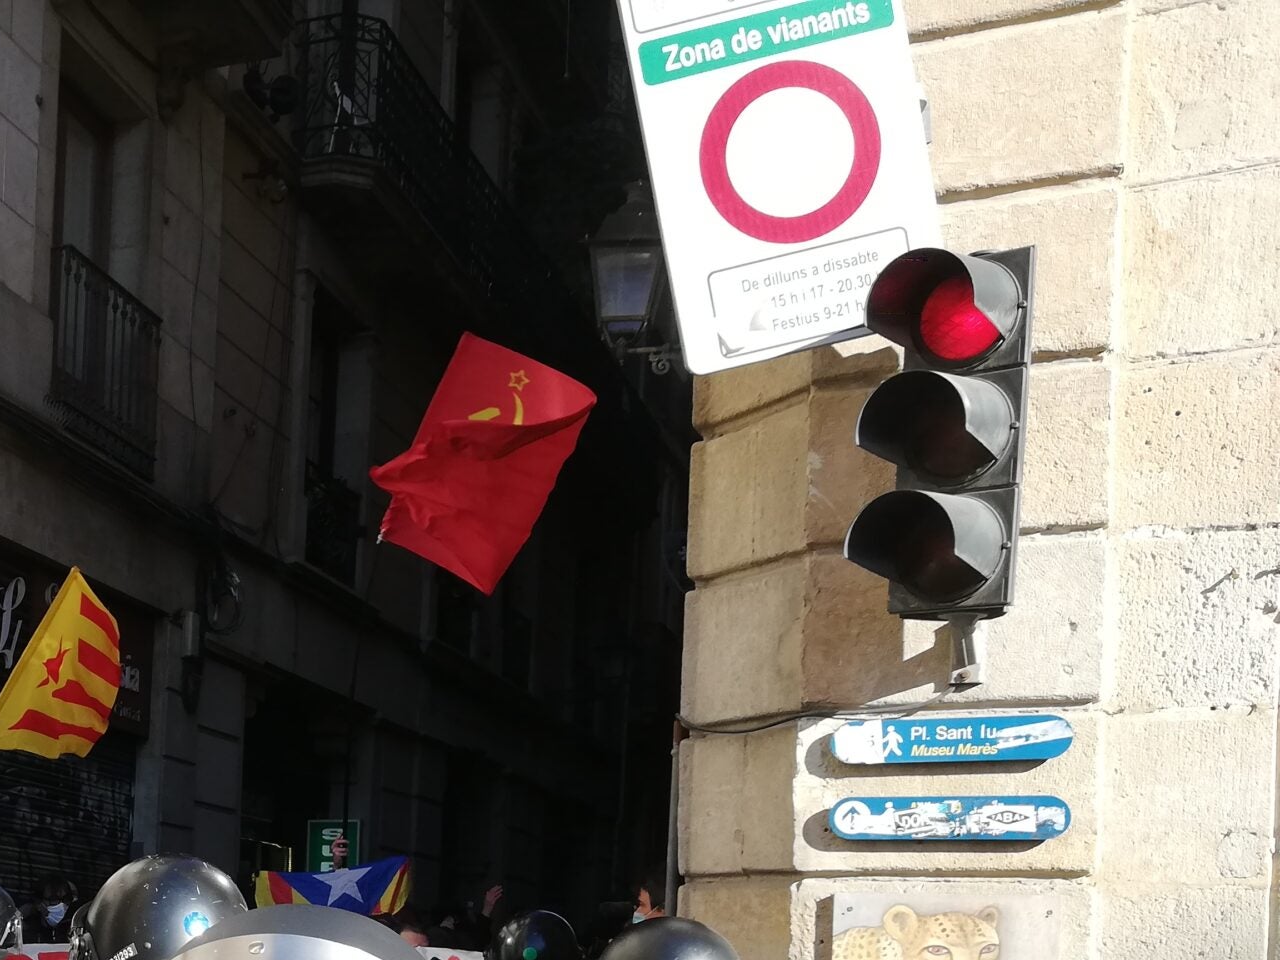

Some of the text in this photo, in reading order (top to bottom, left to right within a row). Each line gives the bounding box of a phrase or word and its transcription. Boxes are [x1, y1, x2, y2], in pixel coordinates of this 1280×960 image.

[661, 1, 871, 72] Zona de vianants
[741, 249, 879, 293] De dilluns a dissabte
[771, 294, 786, 308] 15
[790, 291, 799, 305] h
[802, 290, 806, 302] i
[810, 284, 824, 299] 17
[772, 312, 820, 332] Festius
[823, 302, 850, 320] 9-21
[910, 725, 931, 741] Pl.
[935, 725, 973, 740] Sant
[910, 743, 998, 757] Museu Marès
